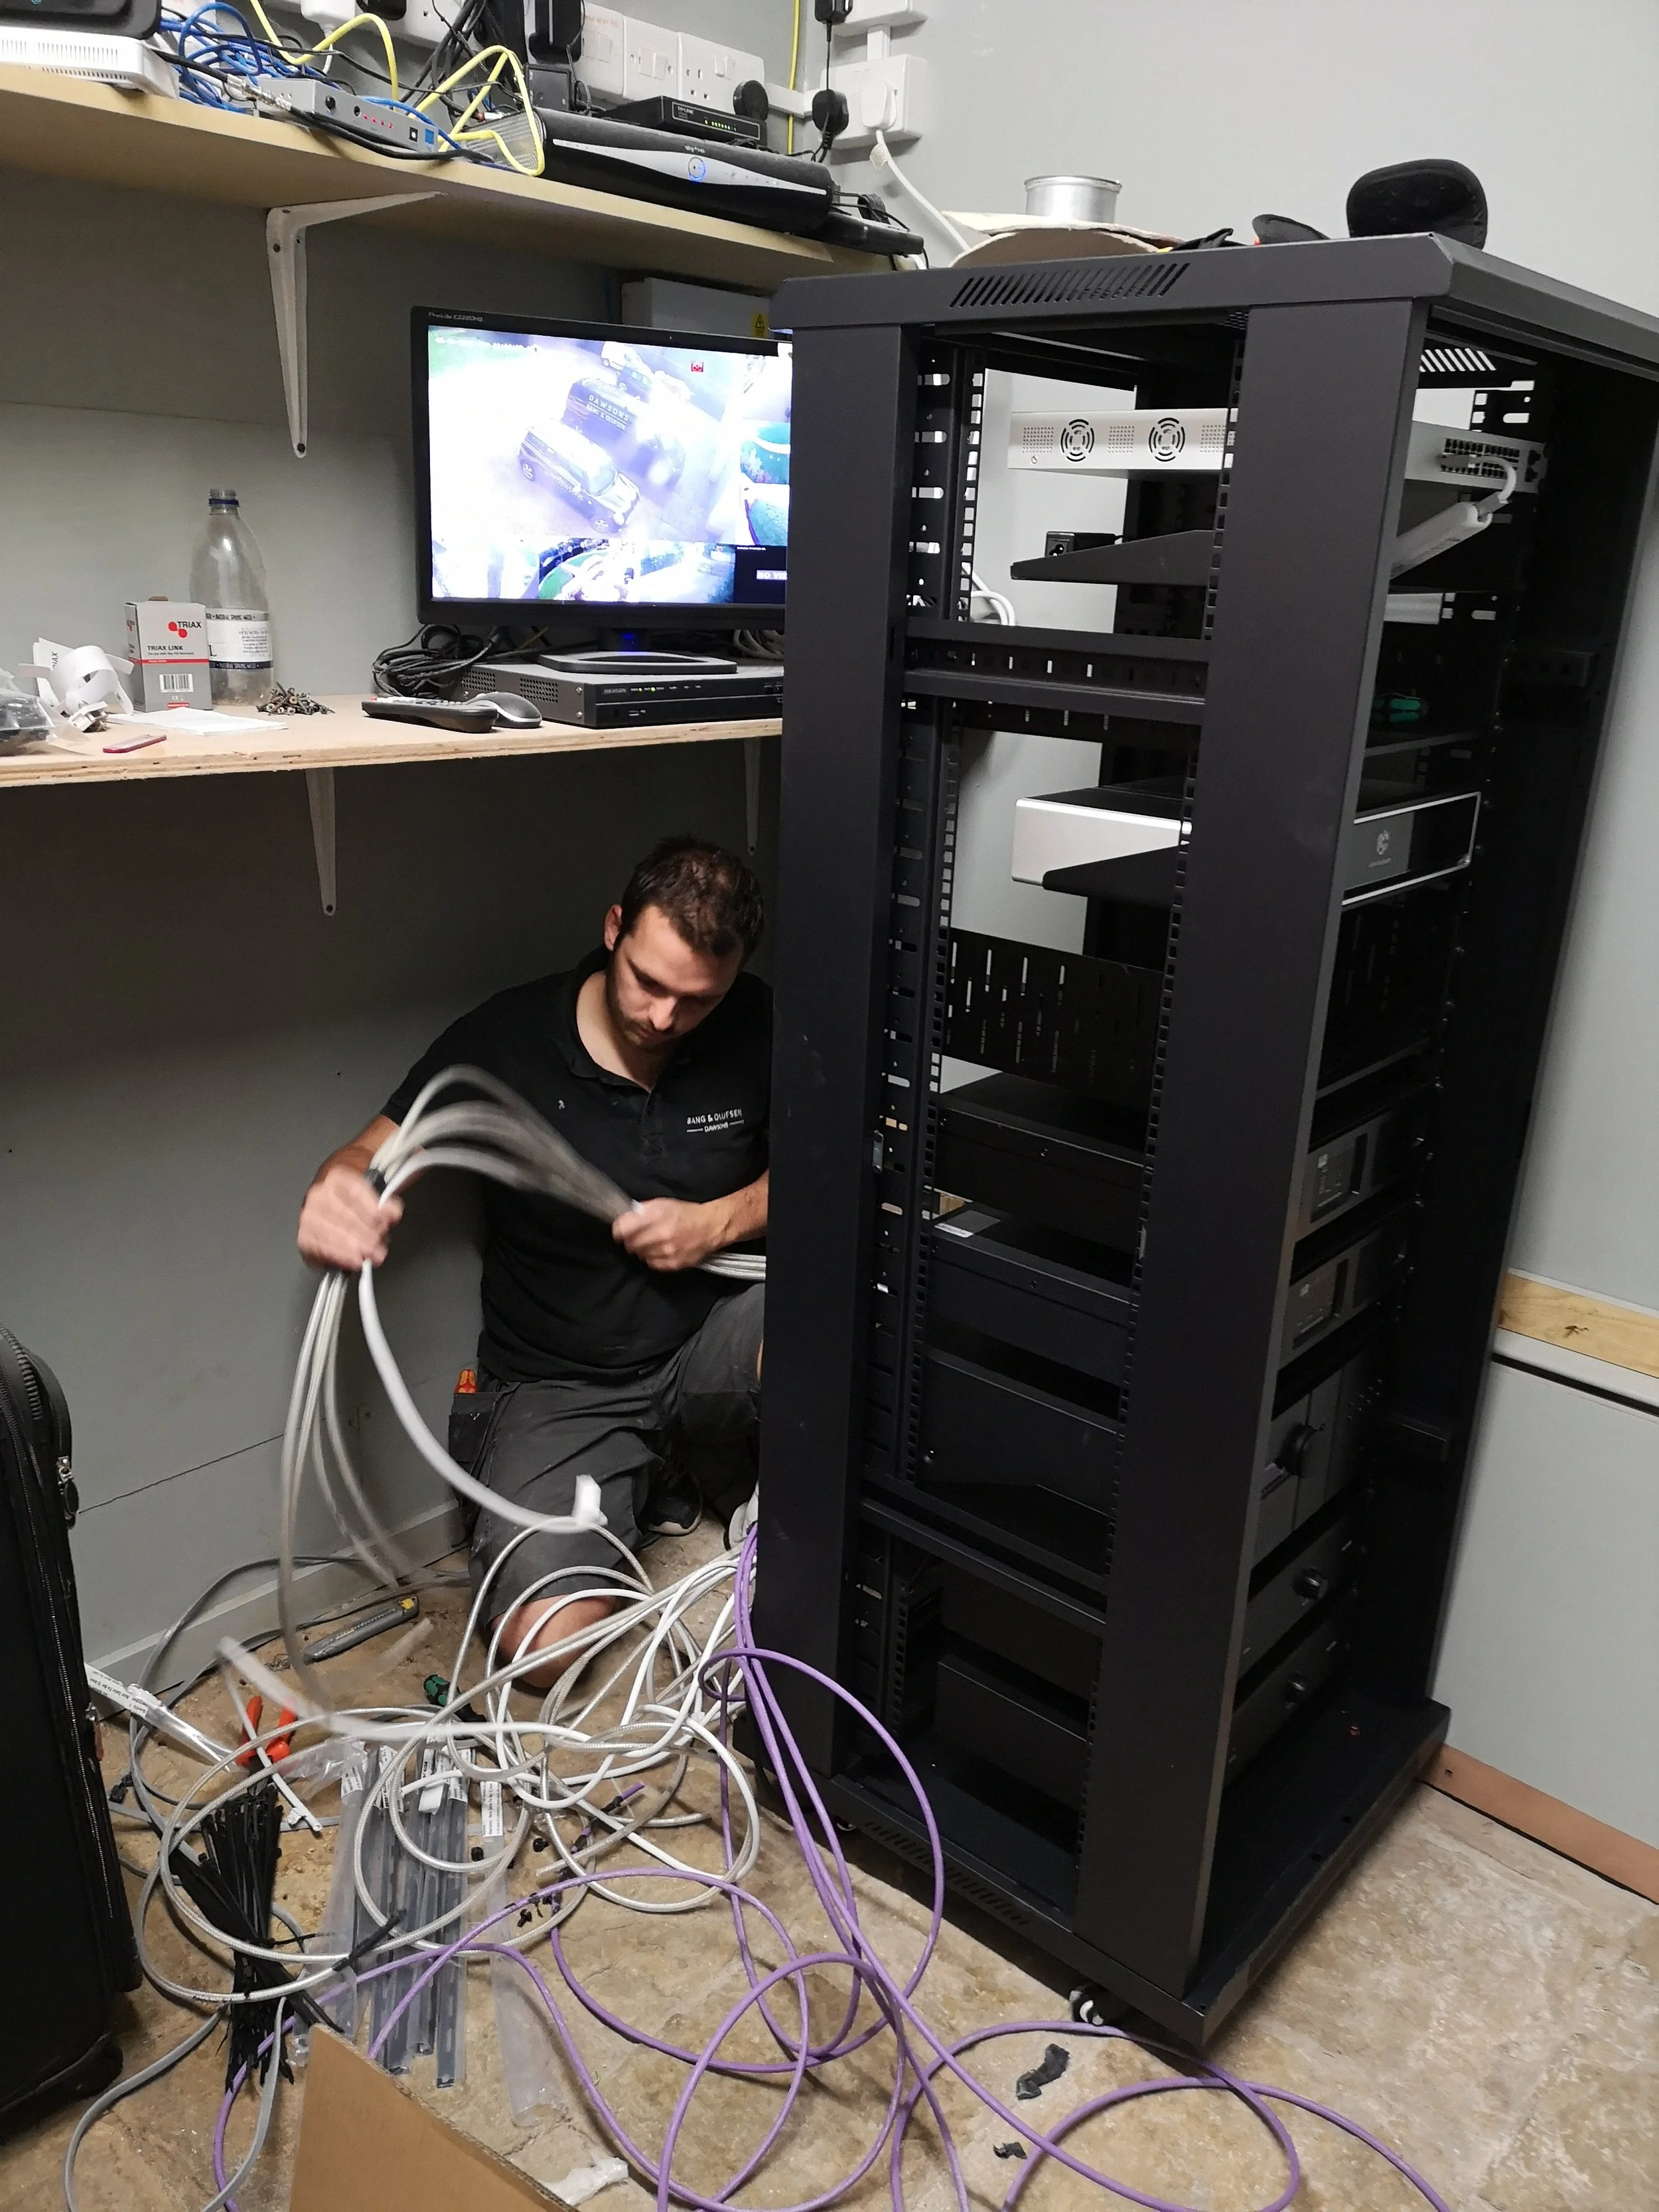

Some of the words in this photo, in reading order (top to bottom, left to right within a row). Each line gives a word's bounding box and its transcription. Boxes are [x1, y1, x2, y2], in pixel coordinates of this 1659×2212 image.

[586, 404, 599, 415] BANG
[589, 394, 630, 421] DAWSONS
[687, 1115, 706, 1124] BANG
[713, 1108, 743, 1122] OLUFSEN
[704, 1122, 729, 1132] DAWSONS
